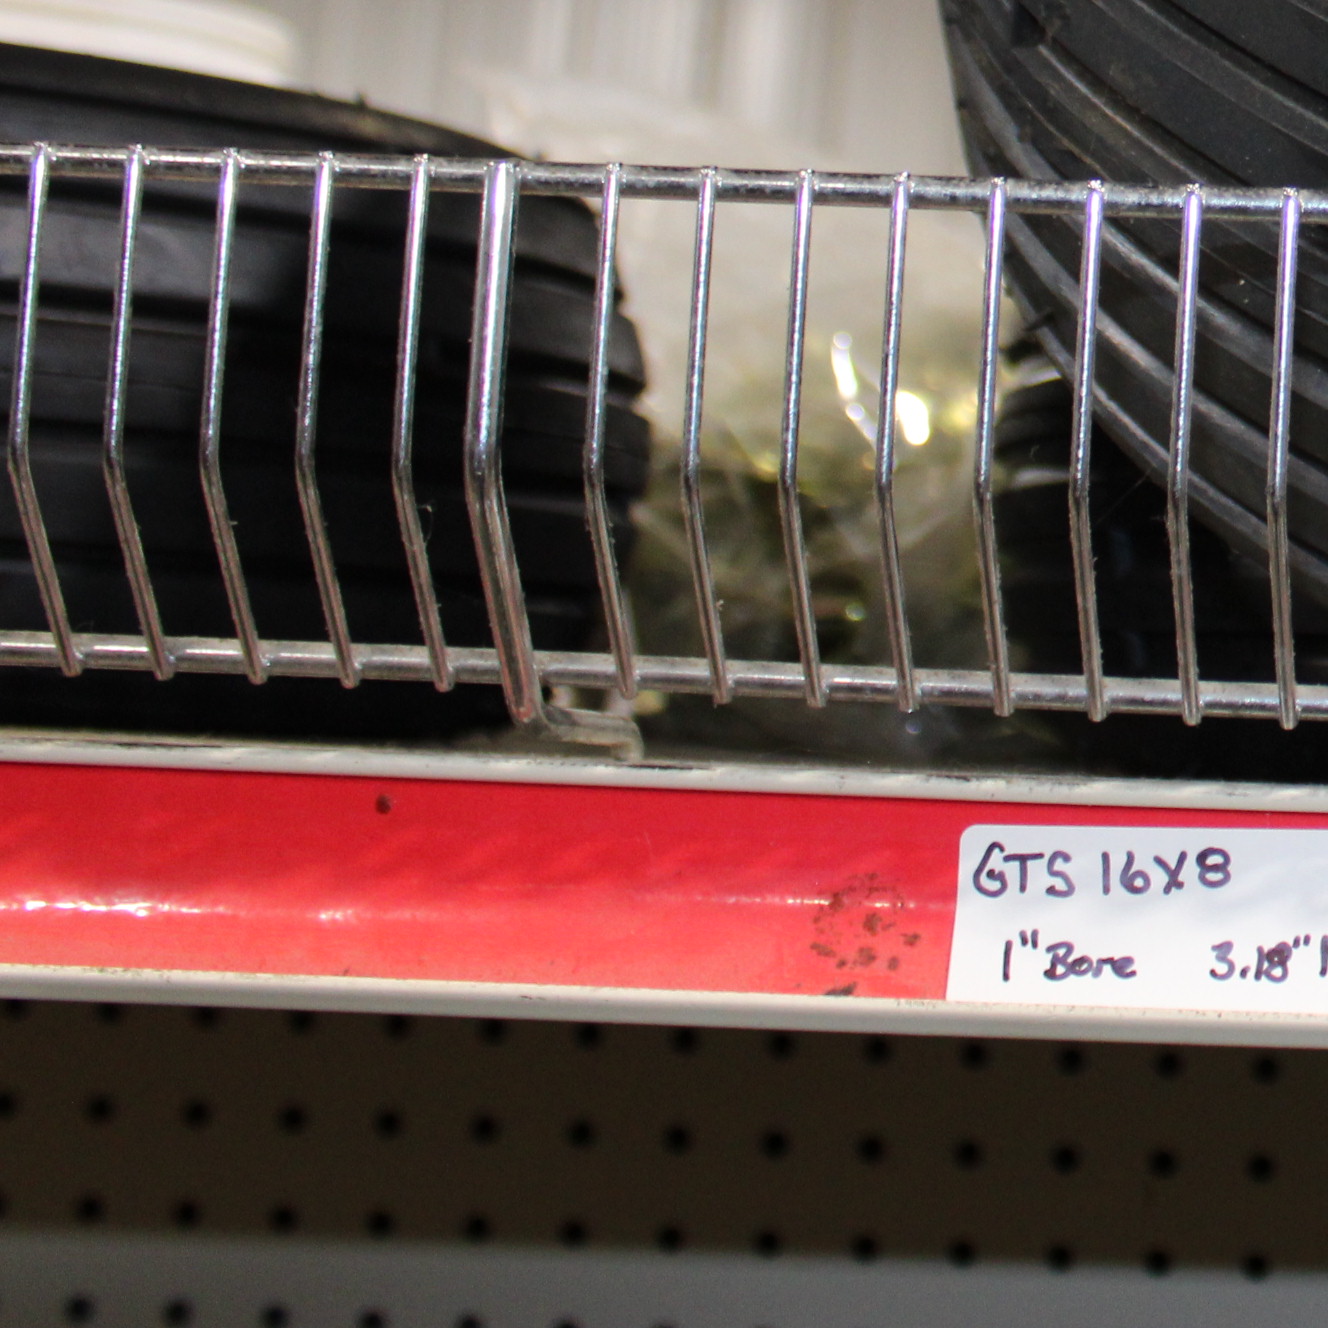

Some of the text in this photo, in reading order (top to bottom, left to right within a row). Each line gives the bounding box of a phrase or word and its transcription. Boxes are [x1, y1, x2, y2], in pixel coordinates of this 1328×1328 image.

[972, 841, 1231, 898] GTS 16X8
[1002, 929, 1039, 982] 1"
[1043, 941, 1137, 981] Bore
